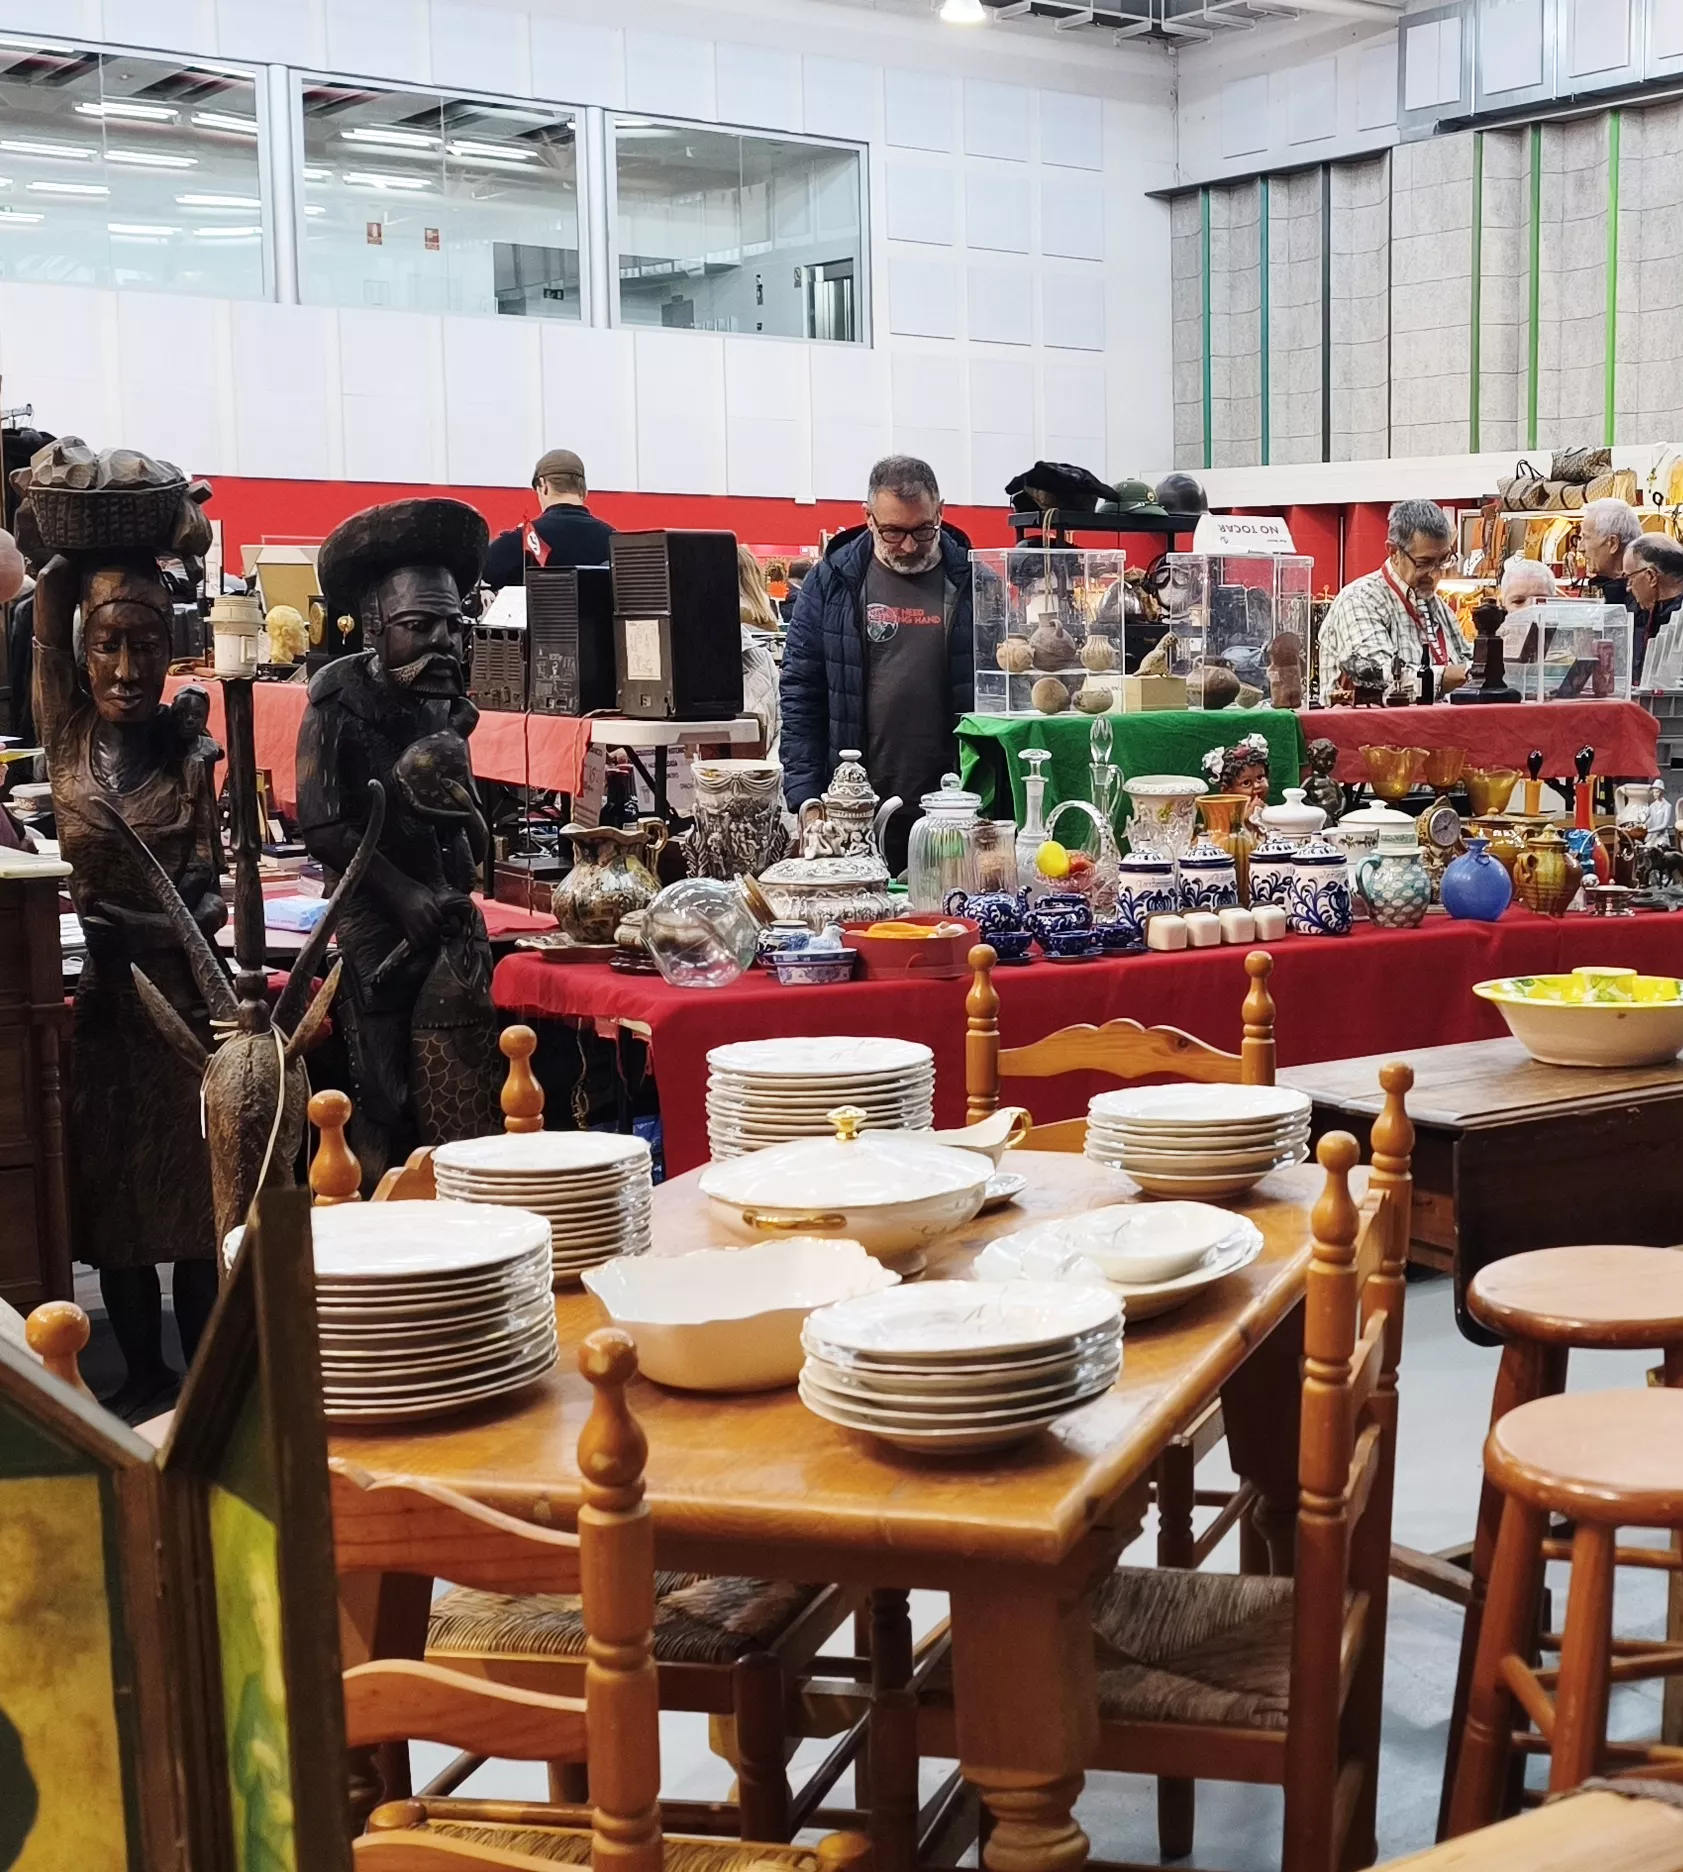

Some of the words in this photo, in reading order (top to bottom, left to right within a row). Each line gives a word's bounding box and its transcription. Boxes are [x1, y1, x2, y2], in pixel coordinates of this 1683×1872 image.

[1218, 524, 1258, 534] TOCAR
[1260, 525, 1279, 534] NO
[914, 615, 941, 624] HAND
